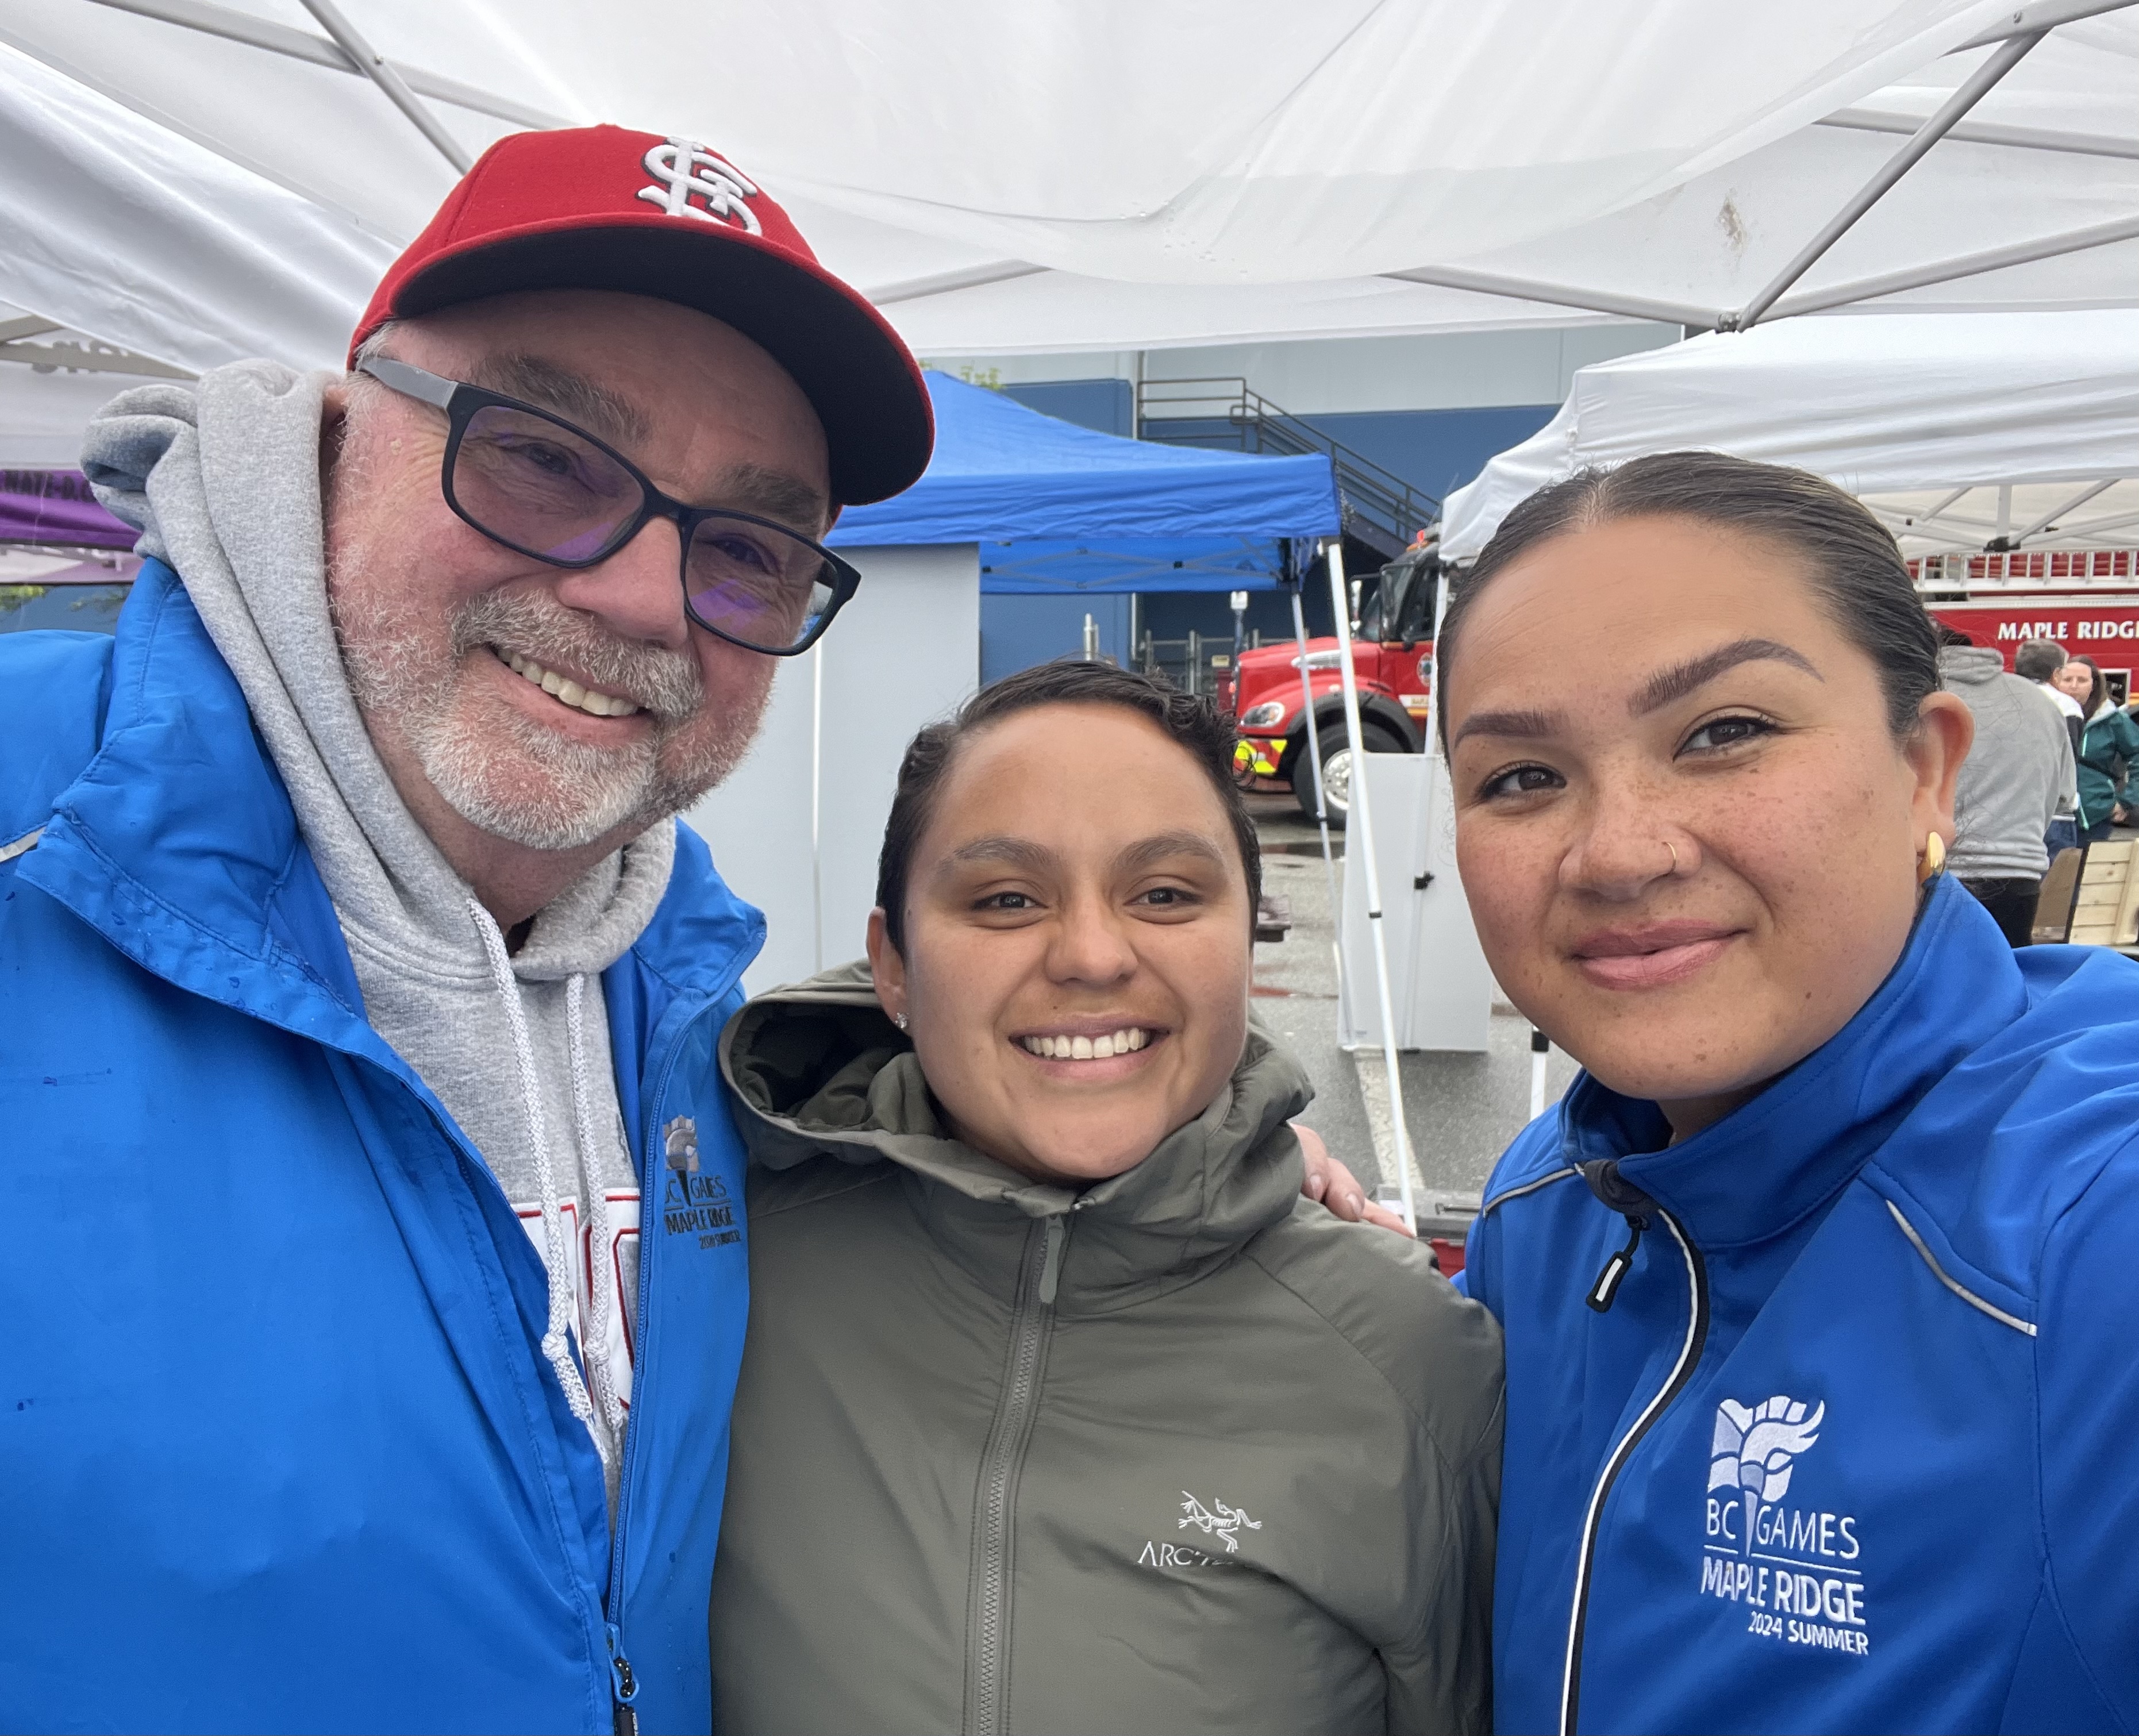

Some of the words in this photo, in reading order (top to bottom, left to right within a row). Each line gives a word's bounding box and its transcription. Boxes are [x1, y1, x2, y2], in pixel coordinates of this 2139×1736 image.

[1998, 622, 2068, 640] MAPLE
[2077, 621, 2139, 640] RIDG
[664, 1208, 707, 1235] MAPLE
[1706, 1498, 1739, 1540] BC
[1756, 1504, 1860, 1560] GAMES
[1700, 1556, 1769, 1607] MAPLE
[1773, 1570, 1867, 1626] RIDGE
[1748, 1610, 1783, 1640] 2024
[1787, 1619, 1869, 1656] SUMMER
